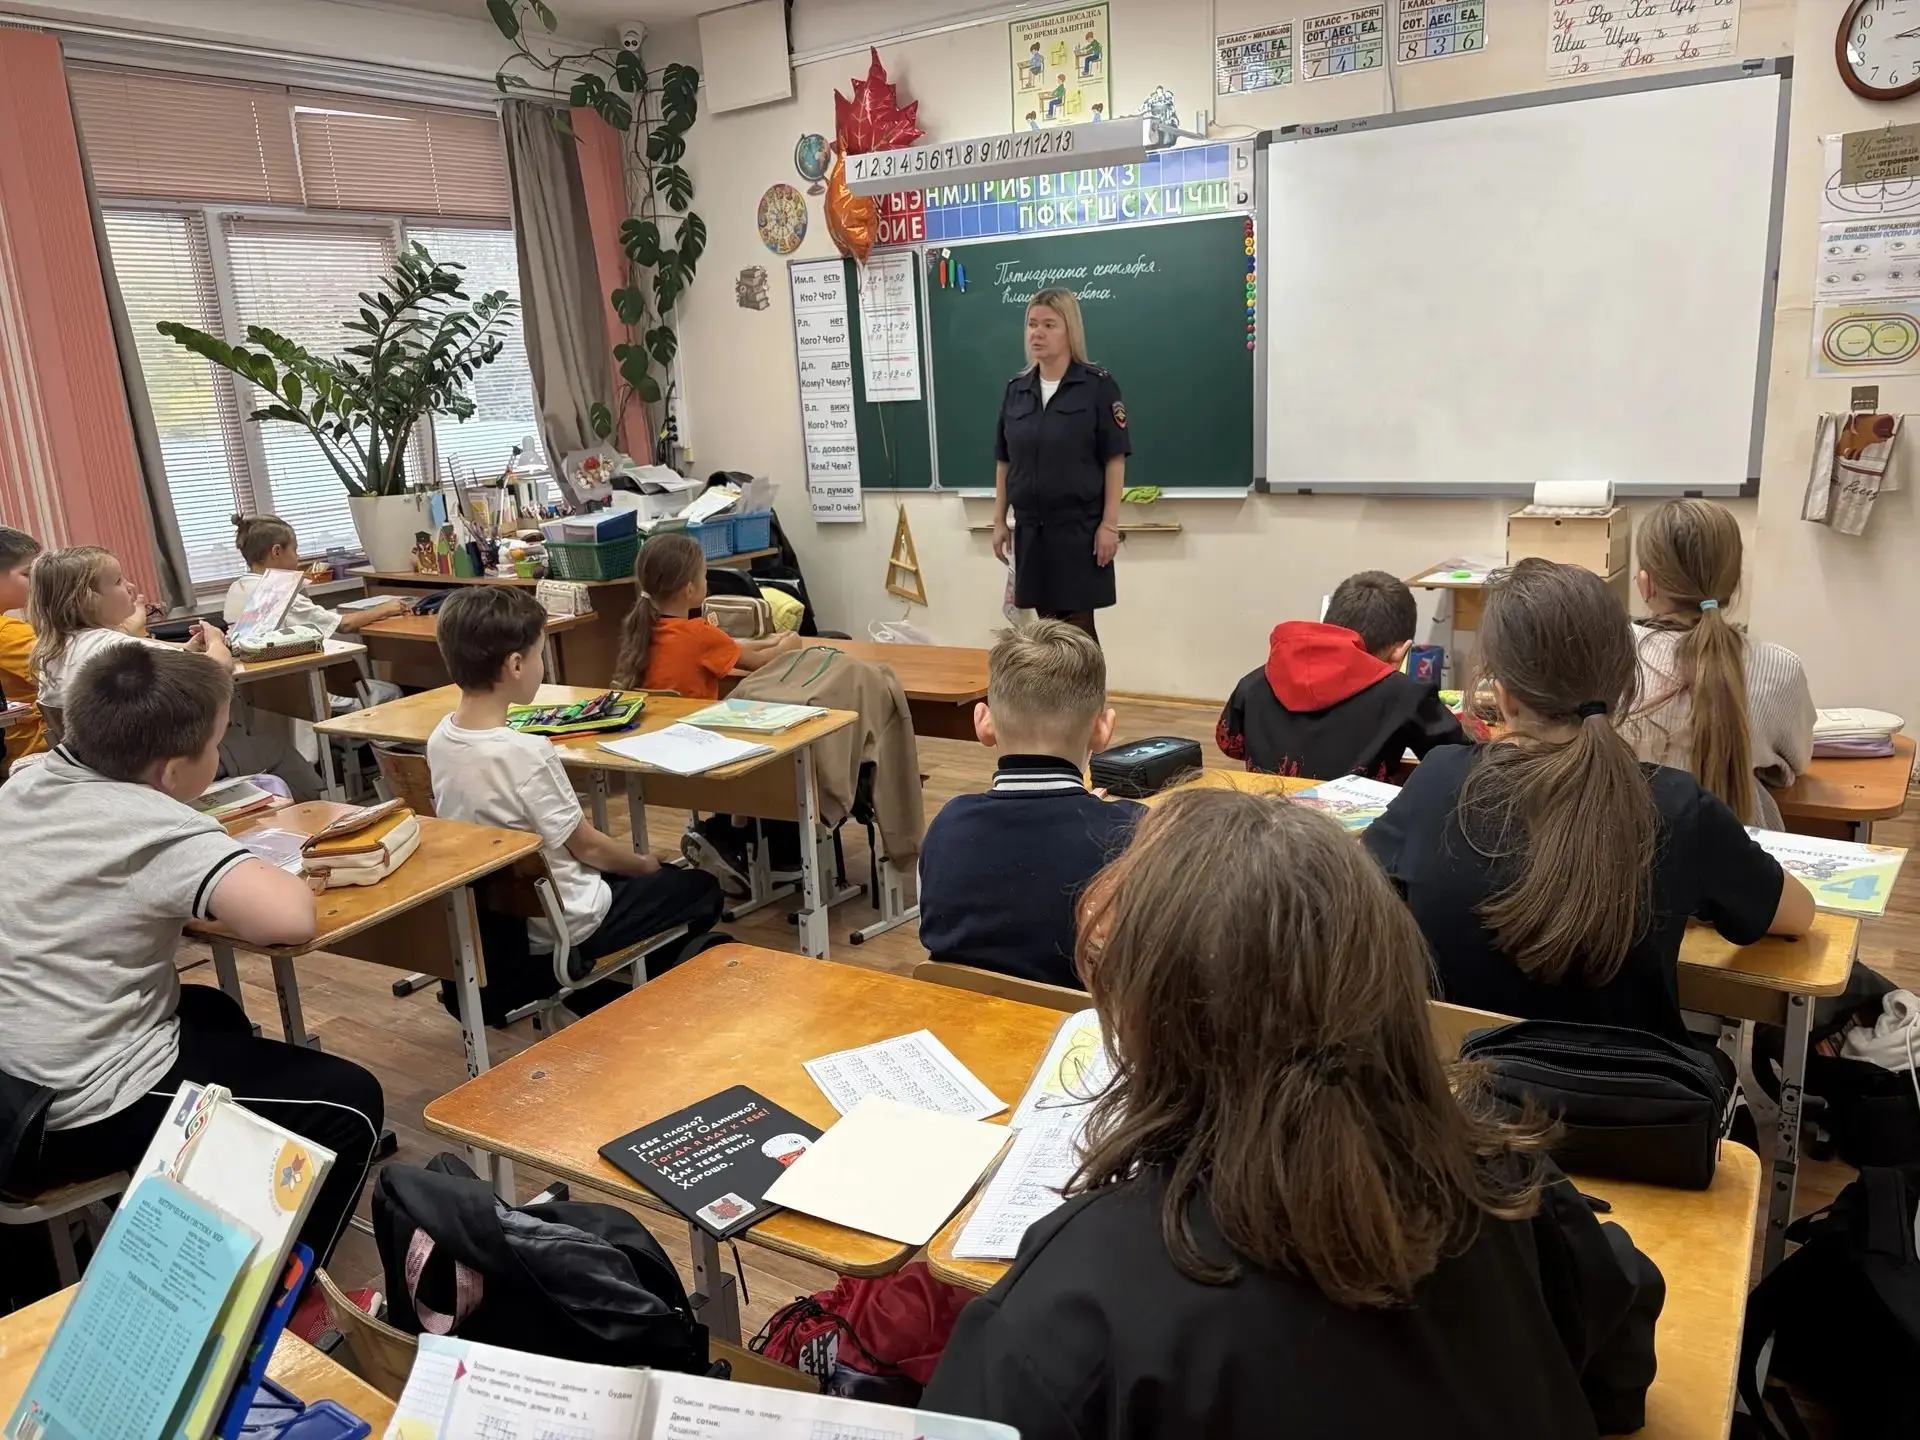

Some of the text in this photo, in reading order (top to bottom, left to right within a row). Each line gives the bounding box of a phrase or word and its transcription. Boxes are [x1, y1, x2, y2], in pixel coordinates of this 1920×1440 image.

[1016, 8, 1102, 32] ПРАВИЛЬНАЯ ПОСАДКА
[1314, 15, 1342, 28] КЛАСС
[1351, 8, 1380, 21] ТЫСЯЧ
[1402, 8, 1479, 30] СОТ. ДЕС. ЕД.
[1860, 14, 1873, 30] 10
[1023, 20, 1095, 41] ВО ВРЕМЯ ЗАНЯТИЙ
[1306, 20, 1378, 42] СОТ. ДЕС. ЕД.
[1226, 34, 1247, 45] КЛАСС
[1406, 41, 1418, 59] 8
[1433, 37, 1447, 55] 3
[1463, 32, 1475, 50] 6
[1857, 33, 1867, 49] 9
[1221, 39, 1288, 60] СОТ. ДЕС. ЕД.
[1311, 60, 1322, 77] 7
[1336, 55, 1346, 72] 4
[1363, 50, 1374, 67] 5
[1856, 51, 1866, 67] 8
[1870, 66, 1880, 81] 7
[1912, 60, 1920, 75] 5
[1889, 70, 1898, 85] 6
[1314, 124, 1339, 134] Board
[855, 130, 1072, 178] 1 2 3 4 5 6 7 8 9 10 11 12 13
[1879, 155, 1920, 167] огромное
[1864, 165, 1908, 180] СЕРДЦЕ
[912, 216, 923, 239] Е
[1019, 203, 1033, 228] П
[1037, 201, 1055, 226] Ф
[1060, 203, 1073, 223] К
[1099, 197, 1117, 220] Ш
[1842, 231, 1882, 241] ПОВЫШЕНИЯ
[1882, 229, 1912, 238] ОСТРОТЫ
[1844, 225, 1877, 234] КОМПЛЕКС
[794, 273, 841, 285] Им.п. есть
[800, 290, 837, 303] Кто? Что?
[1072, 281, 1116, 300] абота.
[797, 317, 844, 328] Р.п. нет
[800, 334, 845, 346] Кого? Чего?
[801, 361, 850, 372] Д.п. дать
[801, 376, 851, 390] Кому? Чему?
[804, 403, 850, 413] В.п. вижу
[807, 419, 848, 430] Кого? Что?
[808, 444, 855, 456] Т.п. доволен
[811, 461, 852, 471] Кем? Чем?
[812, 486, 854, 497] П.п. думаю
[818, 503, 835, 512] ком?
